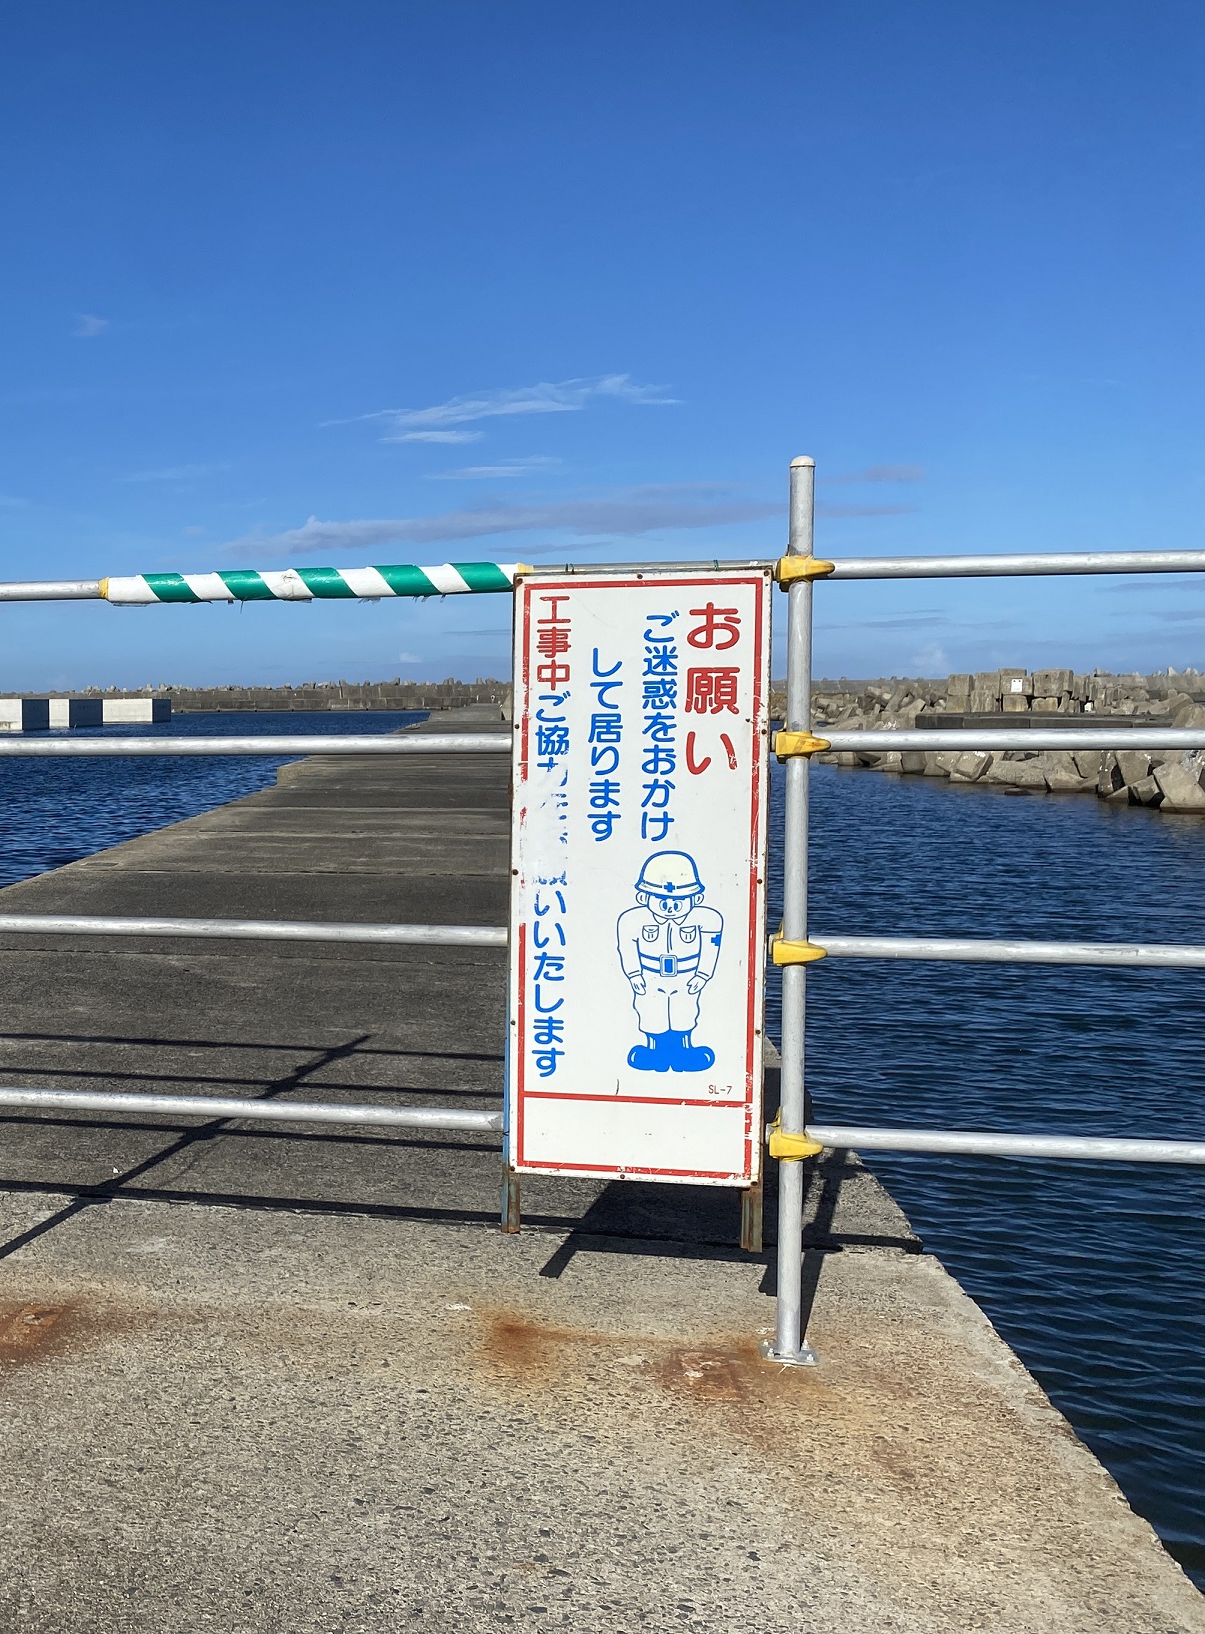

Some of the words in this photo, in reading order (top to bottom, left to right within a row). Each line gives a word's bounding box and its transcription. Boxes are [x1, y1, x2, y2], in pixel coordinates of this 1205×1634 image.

[587, 647, 623, 841] して居ります
[640, 610, 679, 841] ご迷惑をおかけ
[685, 602, 741, 775] お願い
[708, 1084, 733, 1095] SL-7
